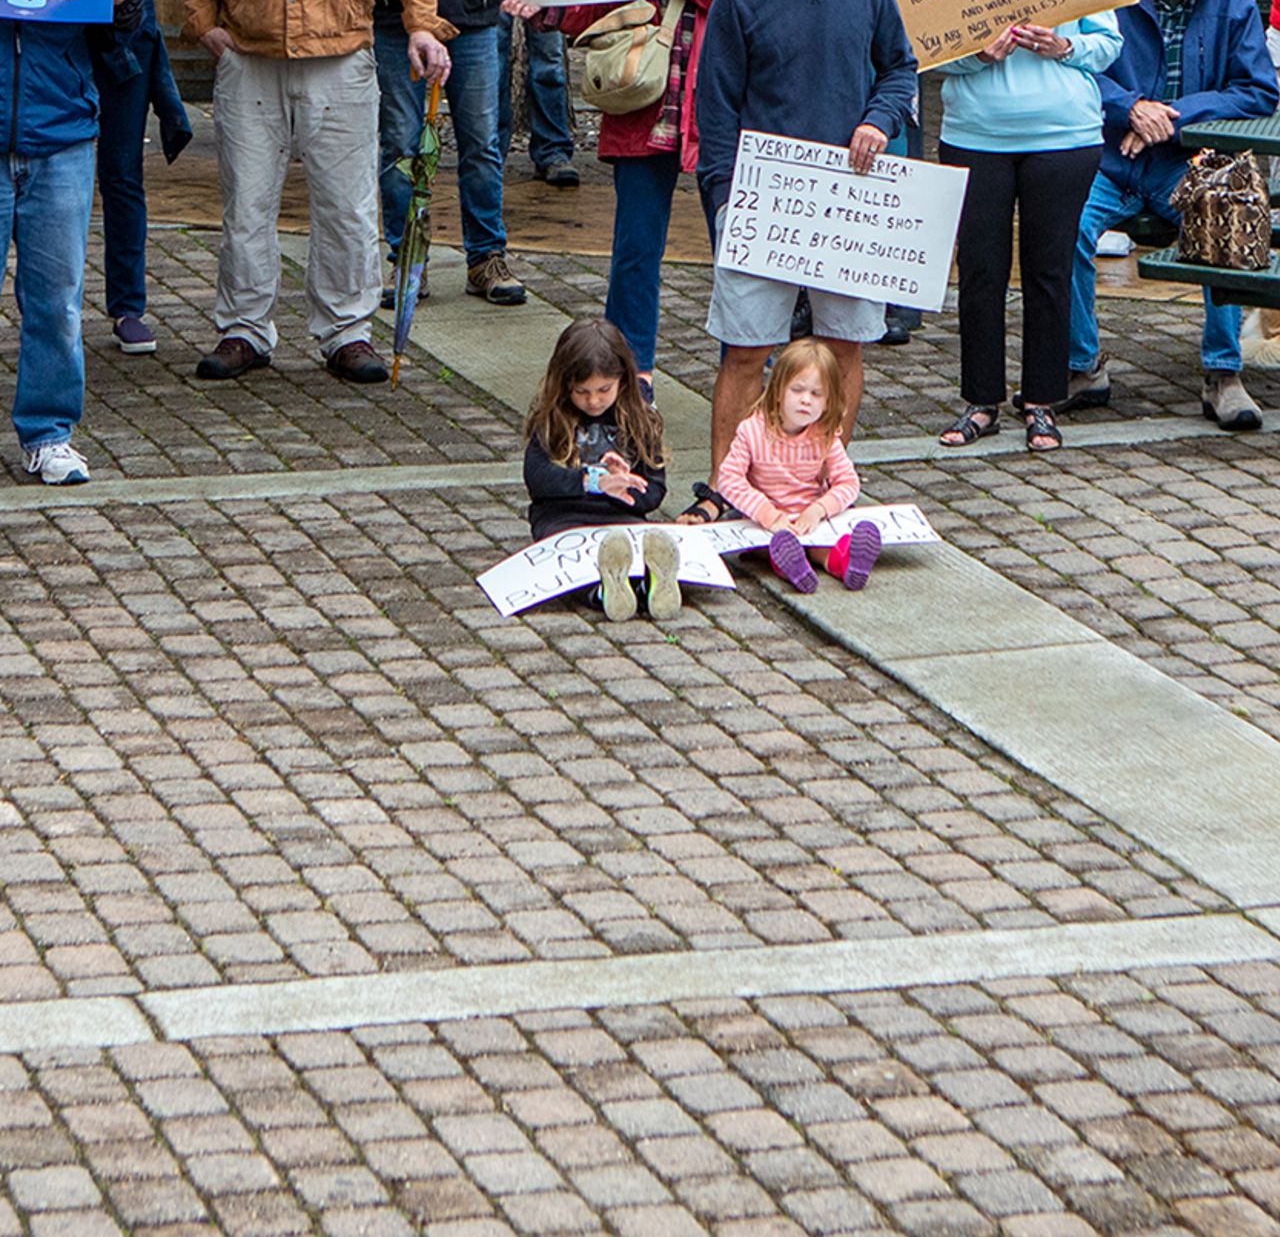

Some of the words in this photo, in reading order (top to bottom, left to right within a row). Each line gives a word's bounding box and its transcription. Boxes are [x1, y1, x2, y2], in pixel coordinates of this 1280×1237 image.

[961, 7, 983, 19] AND
[944, 29, 961, 44] ARE
[967, 20, 989, 35] NOT
[825, 152, 844, 166] IN
[870, 159, 914, 177] ERICA:
[768, 173, 818, 193] SHOT
[848, 186, 901, 209] KILLED
[733, 190, 760, 210] 22
[772, 196, 816, 217] KIDS
[834, 207, 880, 227] TEENS
[886, 217, 924, 230] SHOT
[729, 216, 758, 241] 65
[767, 224, 801, 246] DIE
[809, 232, 827, 248] BY
[830, 236, 864, 252] GUN
[866, 242, 927, 265] SUICIDE
[726, 242, 750, 267] 42
[766, 250, 825, 278] PEOPLE
[838, 267, 919, 295] MURDERED
